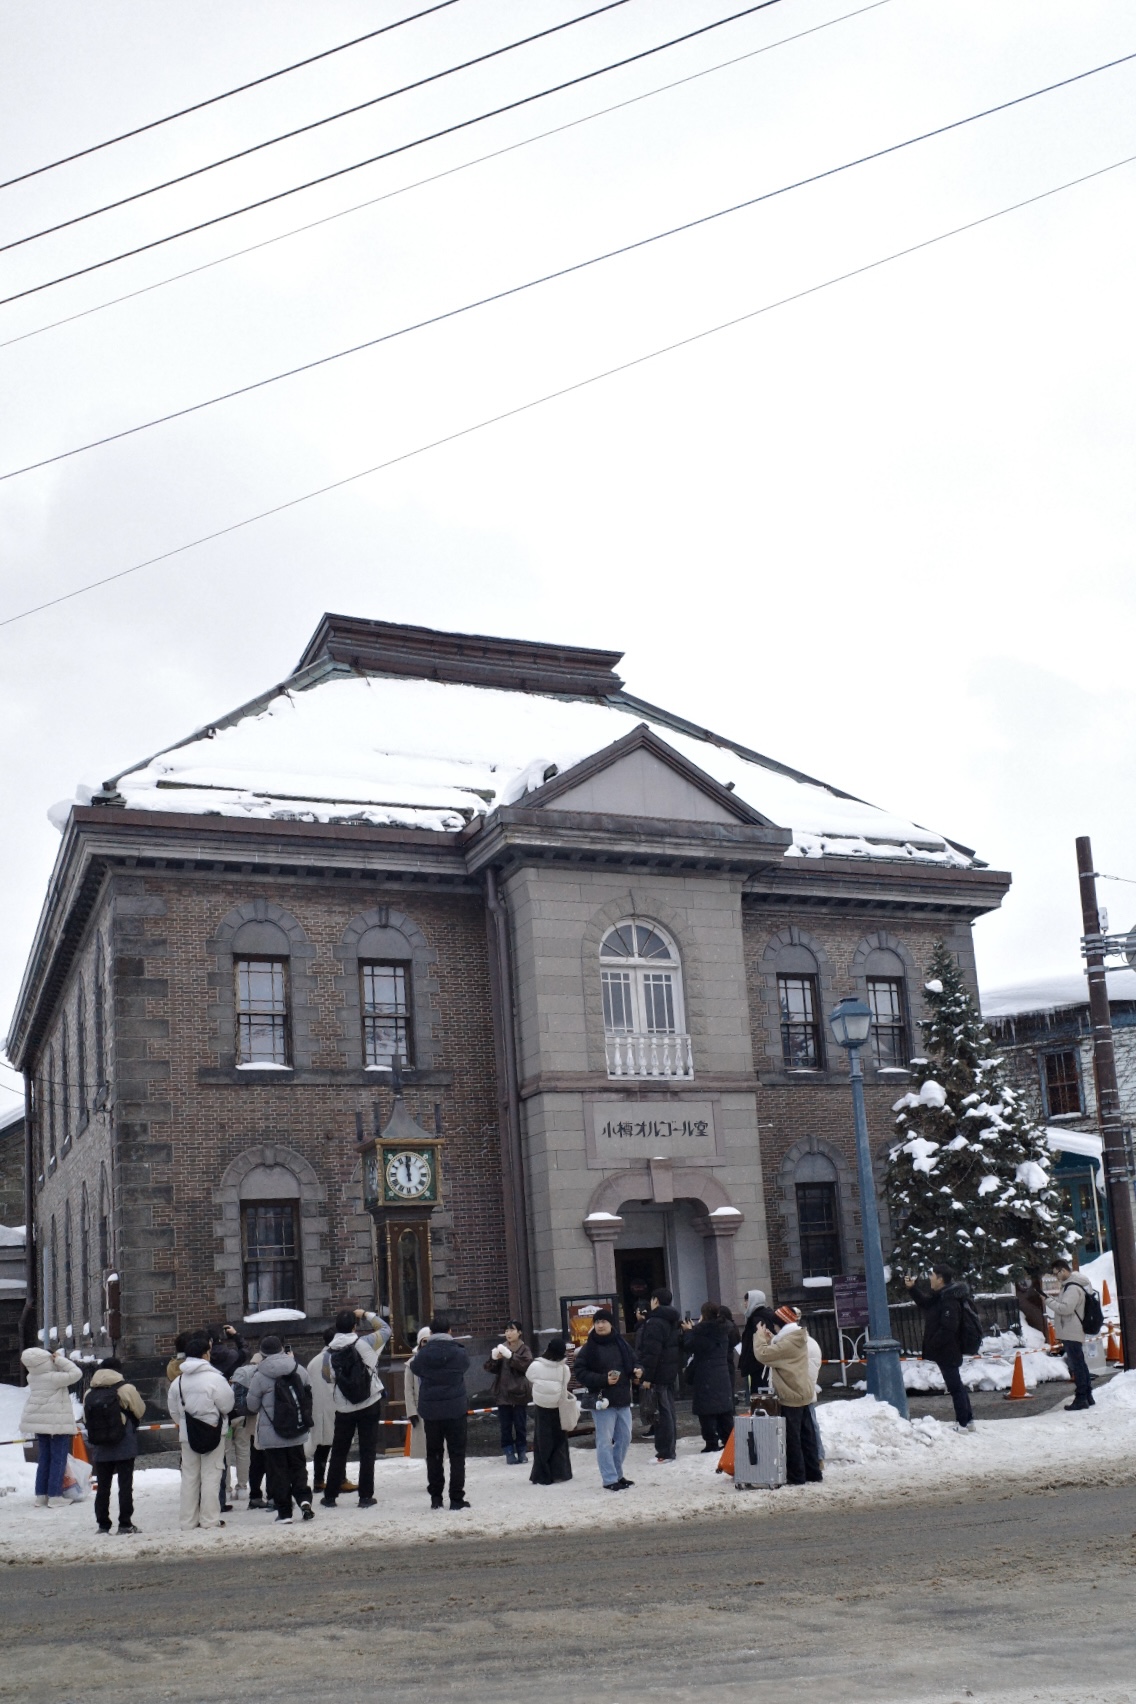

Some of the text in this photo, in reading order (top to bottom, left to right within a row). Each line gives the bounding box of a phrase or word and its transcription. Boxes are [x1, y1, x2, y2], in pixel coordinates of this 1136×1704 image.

[602, 1120, 709, 1138] 小樽オルゴール堂
